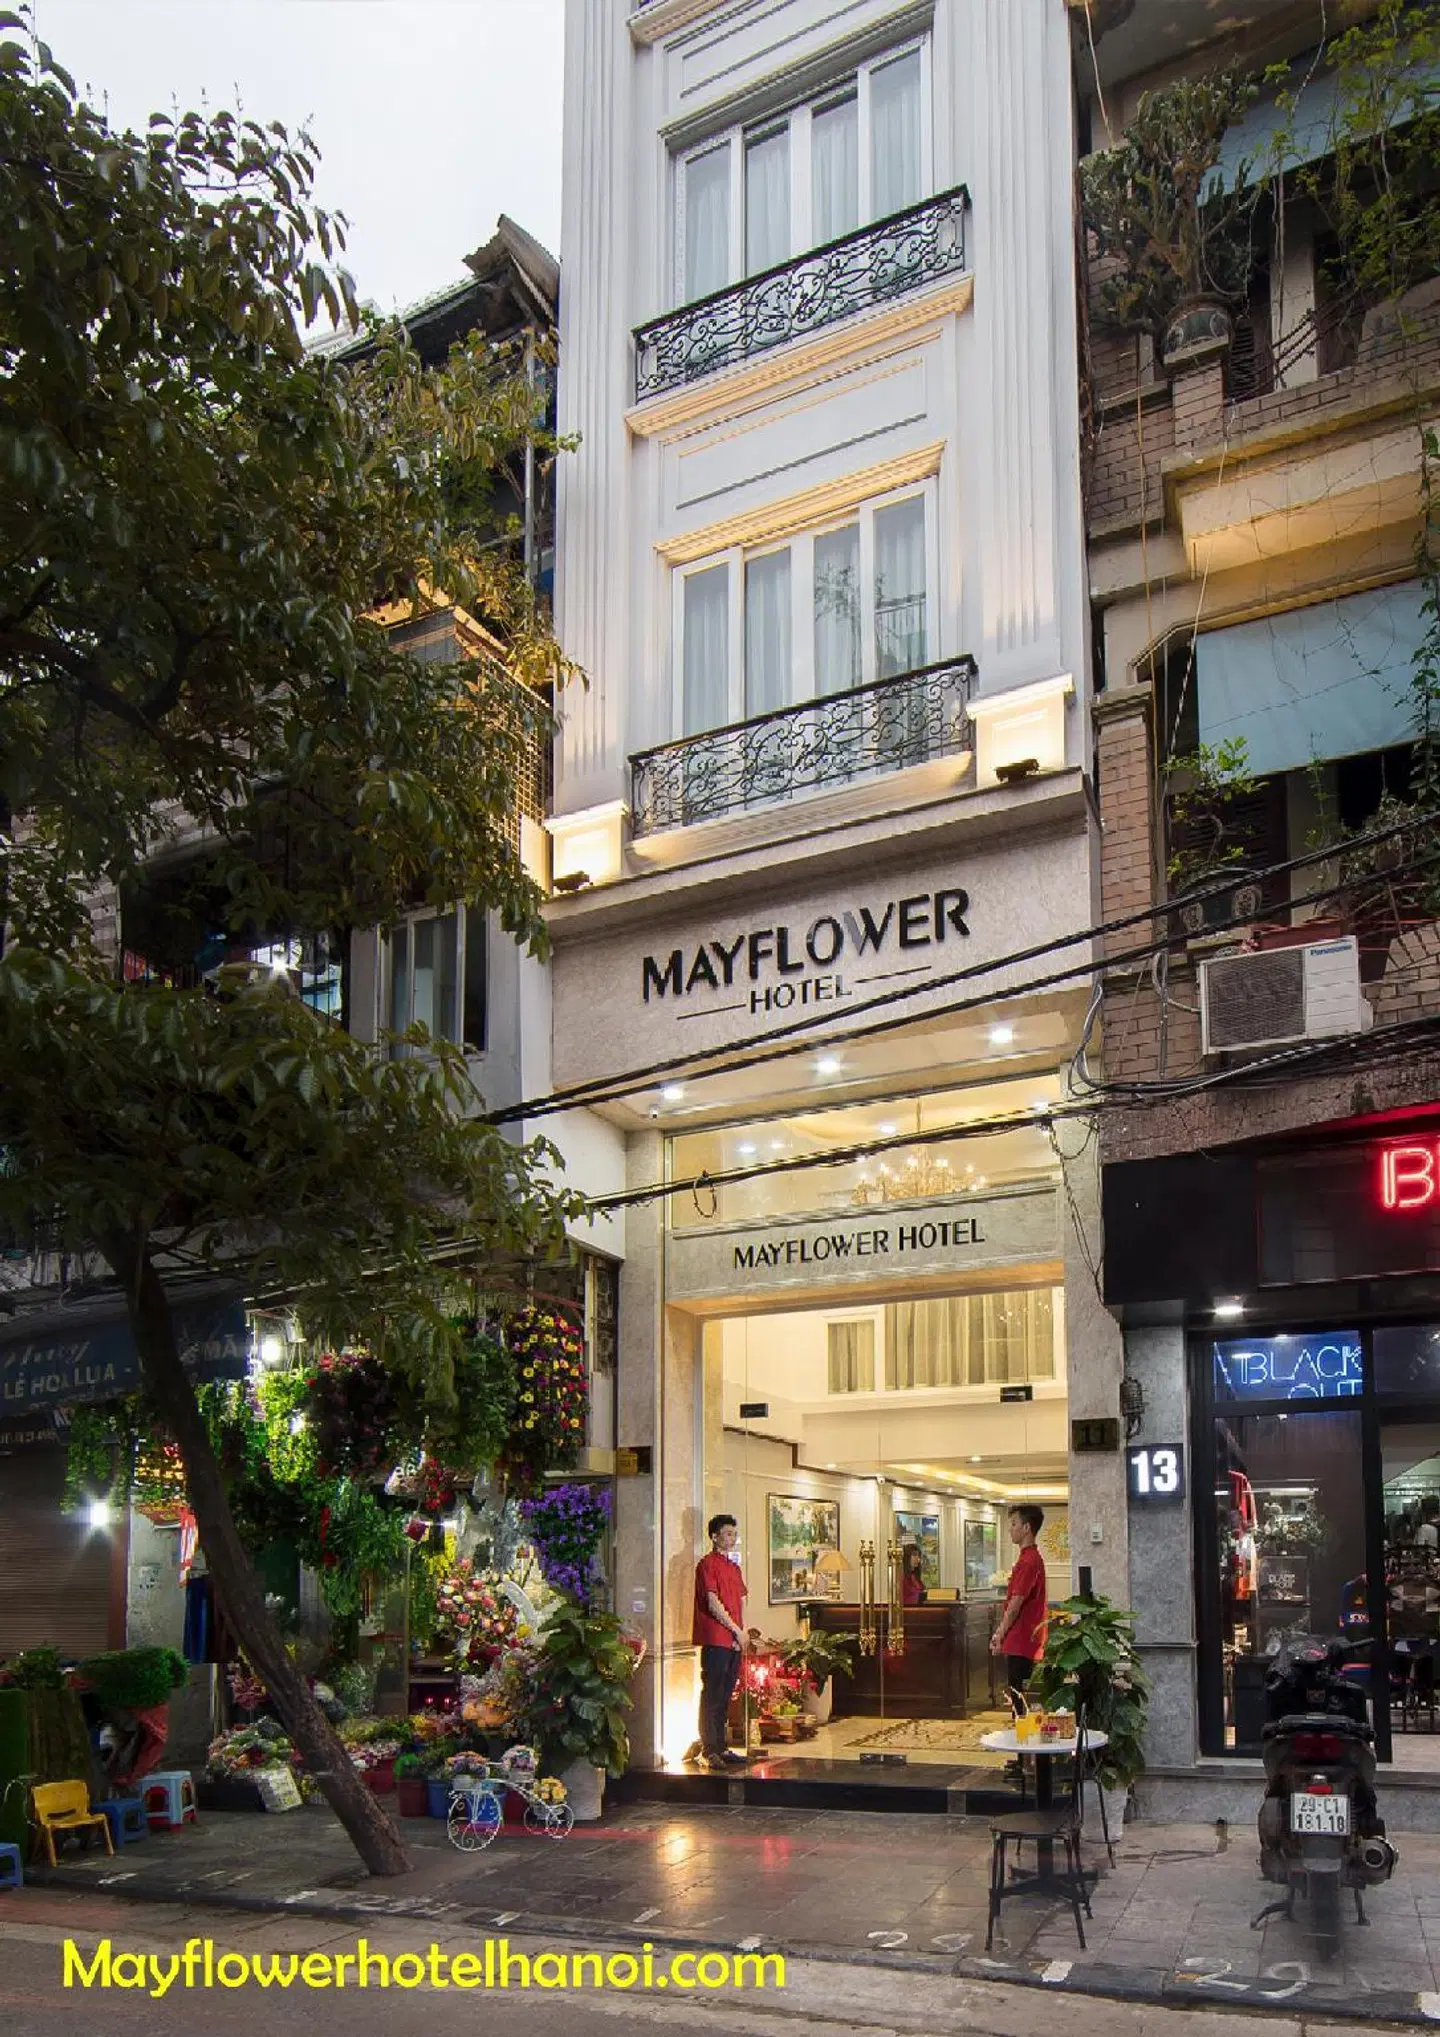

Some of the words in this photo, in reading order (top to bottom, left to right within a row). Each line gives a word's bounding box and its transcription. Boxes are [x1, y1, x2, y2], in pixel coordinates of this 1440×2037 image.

[642, 888, 971, 1003] MAYFLOWER
[750, 975, 853, 1014] HOTEL
[1380, 1142, 1440, 1208] B
[733, 1229, 890, 1270] MAYFLOWER
[899, 1218, 987, 1251] HOTEL
[1240, 1345, 1363, 1385] BLACK
[1130, 1449, 1178, 1493] 13
[1300, 1796, 1339, 1814] 29-C1
